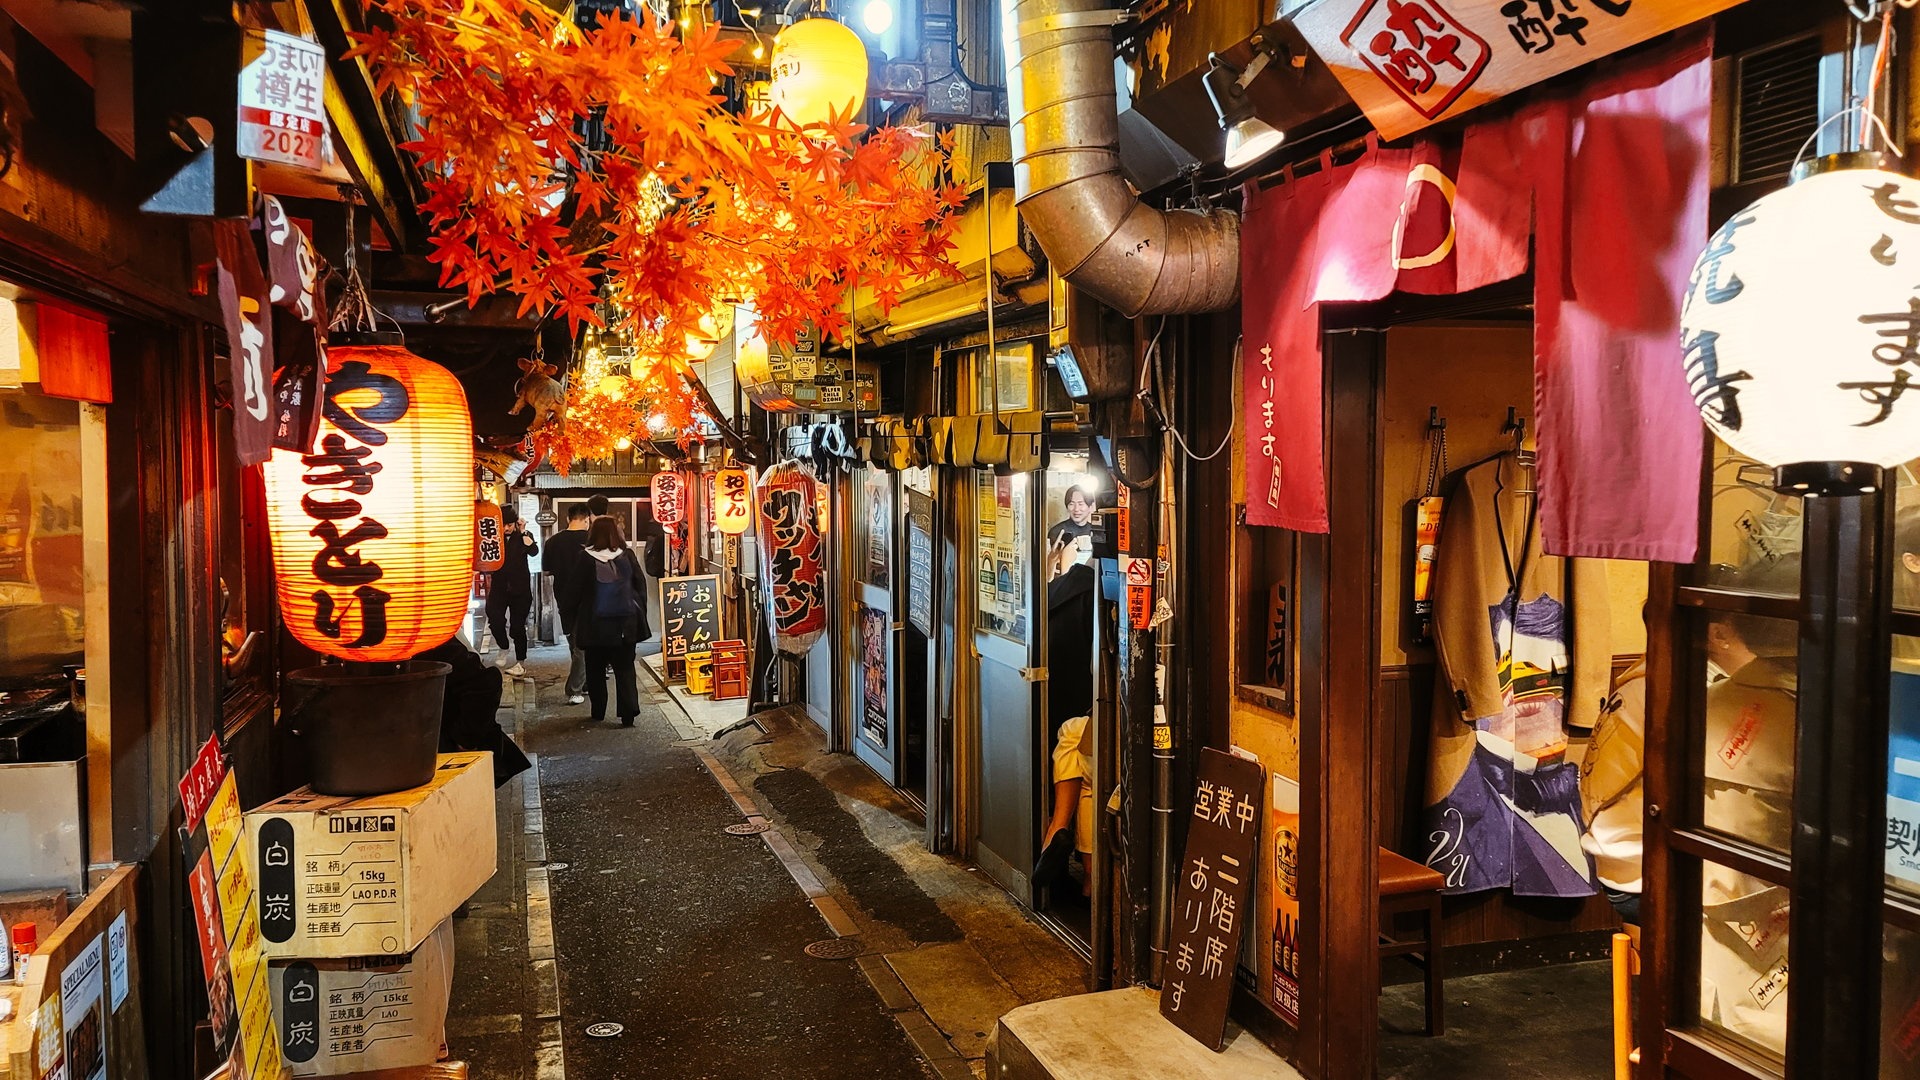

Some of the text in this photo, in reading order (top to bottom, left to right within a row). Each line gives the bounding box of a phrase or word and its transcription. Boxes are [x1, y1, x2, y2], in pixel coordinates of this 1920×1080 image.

[256, 67, 317, 114] 樽生
[269, 112, 311, 133] 認定店
[263, 130, 315, 160] 2022
[1260, 343, 1276, 459] もります
[301, 361, 412, 648] やきとり
[724, 475, 746, 517] おでん
[480, 518, 500, 561] 串焼
[692, 584, 713, 642] おでん
[1131, 586, 1144, 626] 路上喫煙禁止
[1194, 780, 1254, 833] 営業中
[264, 841, 291, 920] 白炭
[306, 882, 340, 894] 正味重量
[359, 870, 385, 881] 15kg
[306, 902, 340, 914] 生産地
[352, 889, 396, 899] LAO P.D.R
[306, 922, 341, 933] 生産者
[1200, 854, 1240, 980] 二階席
[1171, 856, 1210, 1012] あります
[64, 965, 88, 994] SPECIAL
[286, 980, 315, 1046] 白炭
[383, 993, 409, 1003] 15kg
[1275, 985, 1299, 1015] 取扱店
[381, 1010, 398, 1018] LAO
[330, 1024, 363, 1036] 生産地
[330, 1040, 364, 1052] 生産者
